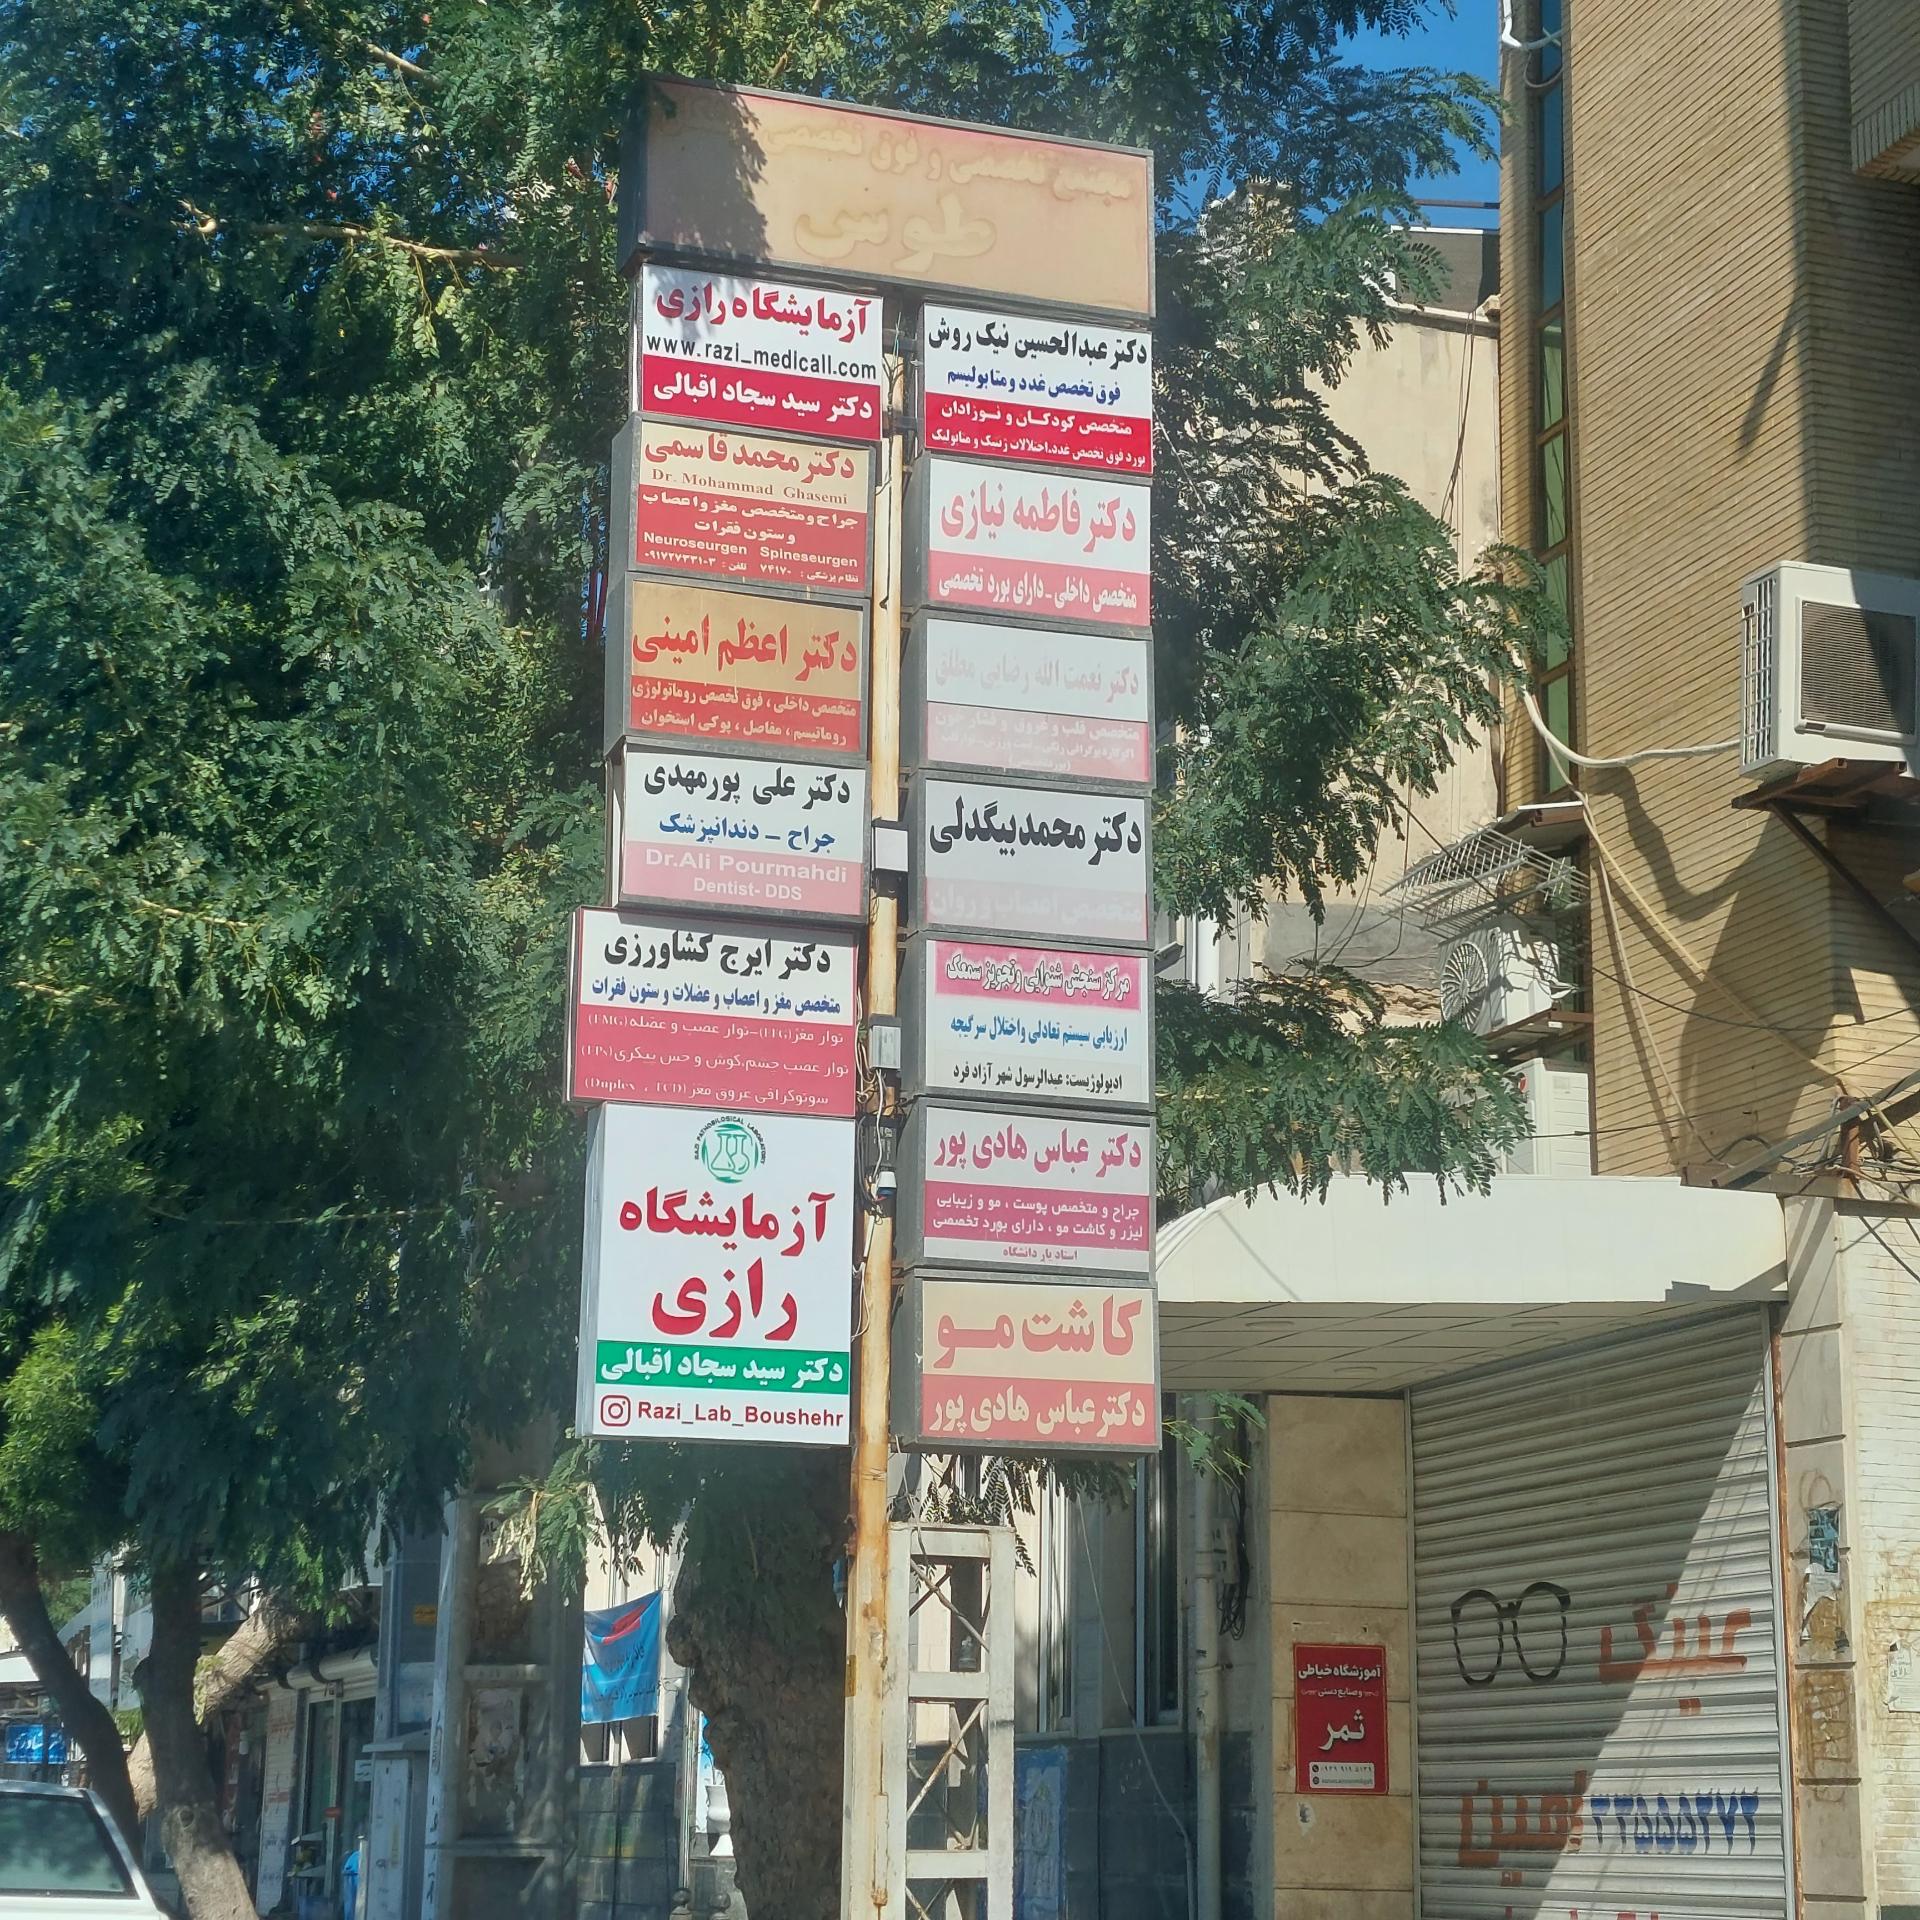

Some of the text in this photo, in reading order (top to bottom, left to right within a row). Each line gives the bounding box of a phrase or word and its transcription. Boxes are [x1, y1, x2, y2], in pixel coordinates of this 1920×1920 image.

[656, 281, 871, 343] آزمایشگاه رازی
[928, 317, 1147, 370] دکتر عبدالحسین نیک روش
[653, 372, 873, 423] دکتر سید سجاد اقبالی
[947, 366, 1121, 406] فوق تخصص غدد متابولیسم
[931, 428, 971, 445] متابولیک
[1078, 418, 1133, 435] متخصص
[644, 432, 855, 484] دکتر محمد قاسمی
[1072, 445, 1104, 461] تخصص
[1106, 448, 1124, 464] فوق
[1126, 451, 1146, 468] بورد
[651, 468, 848, 506] Dr. Mohammad Ghasemi
[642, 490, 858, 530] جراح متخصص مغز اعصاب
[940, 480, 1136, 552] دکتر فاطمه نیازی
[643, 531, 748, 556] Neuroseurgen
[694, 519, 785, 542] ستون فقرات
[728, 560, 747, 571] تلفن
[806, 570, 837, 582] پزشکی
[939, 566, 1137, 613] متخصص داخلی دارای بورد تخصصی
[632, 613, 857, 681] دکتر اعظم امینی
[632, 681, 856, 717] متخصص داخلی فوق تخصص روماتولوژی
[1105, 665, 1139, 703] دکتر
[641, 708, 695, 726] استخوان
[743, 720, 782, 735] مفاصل
[793, 729, 846, 745] روماتیسم
[753, 767, 795, 804] علی
[802, 774, 850, 809] دکتر
[659, 813, 835, 853] جراح دندانپزشک
[929, 795, 1142, 866] دکتر محمد بیگدلی
[719, 857, 847, 882] Pourmahdi
[765, 884, 802, 900] DDS
[604, 930, 831, 979] دکتر ایرج کشاورزی
[946, 953, 1130, 1000] مرکز سنجش شنوایی سمعک
[592, 975, 841, 1016] متخصص مغز اعصاب عضلات ستون فقرات
[682, 1023, 844, 1046] نوار عصب
[950, 1014, 1128, 1051] ارزیابی سیستم تعادلی سرگیجه
[660, 1054, 690, 1066] حس
[784, 1061, 820, 1076] عصب
[824, 1062, 849, 1077] نوار
[1015, 1066, 1064, 1090] عبدالرسول
[933, 1131, 967, 1170] پور
[972, 1123, 1028, 1169] هادی
[1033, 1127, 1089, 1174] عباس
[1095, 1133, 1142, 1178] دکتر
[619, 1186, 836, 1257] آزمایشگاه
[936, 1192, 1140, 1223] جراح متخصص پوست مو زیبایی
[932, 1212, 1143, 1242] لیزر کاشت مو دارای بورد تخصصی
[1003, 1245, 1037, 1259] دانشگاه
[651, 1257, 799, 1341] رازی
[1021, 1294, 1143, 1356] کاشت
[601, 1347, 843, 1389] دکتر سید سجاد اقبالی
[638, 1401, 844, 1427] Razi_Lab_Boushehr
[929, 1385, 1146, 1438] دکتر عباس هادی پور
[1298, 1663, 1381, 1681] آموزشگاه خیاطی
[1318, 1709, 1366, 1751] ثمر
